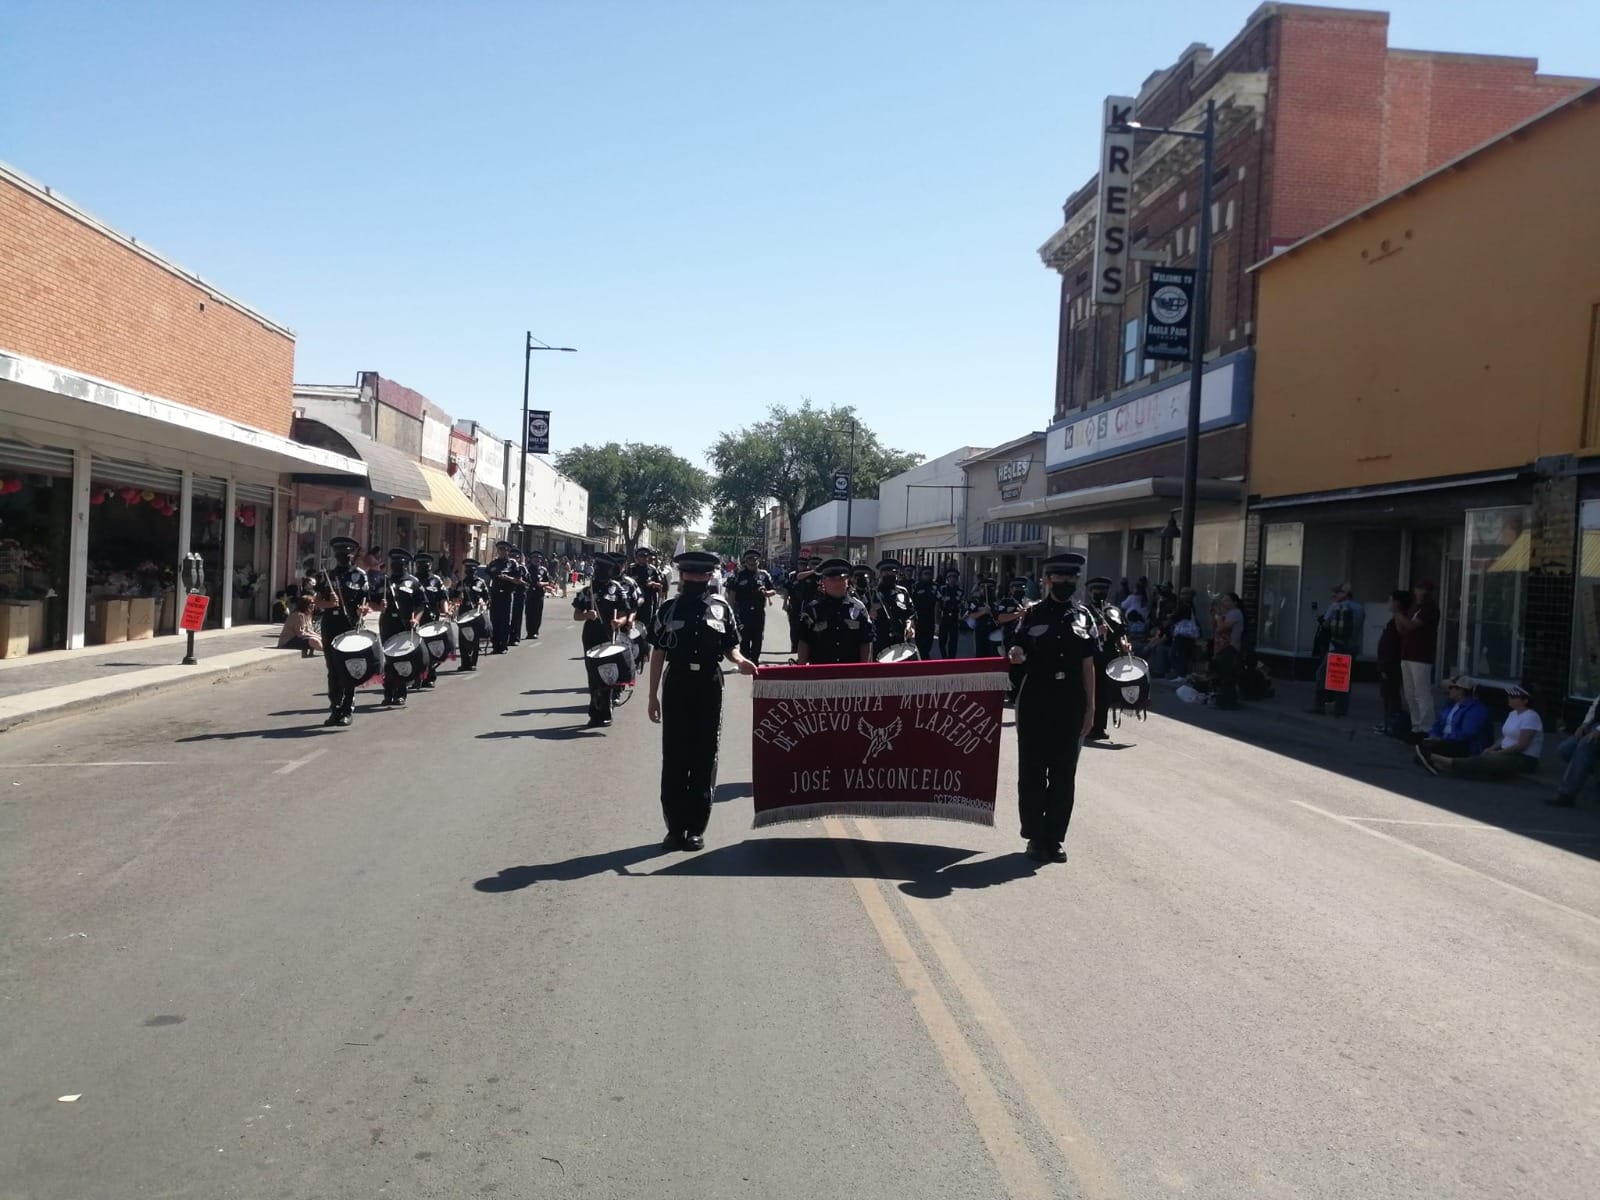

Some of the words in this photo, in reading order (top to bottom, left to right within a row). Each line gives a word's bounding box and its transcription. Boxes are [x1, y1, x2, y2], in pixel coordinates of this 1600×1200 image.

[1102, 104, 1132, 296] KRESS
[753, 694, 884, 744] PREPARATORIA
[900, 690, 999, 744] MUNICIPAL
[772, 730, 798, 753] DE
[793, 712, 850, 739] NUEVO
[914, 708, 981, 755] LAREDO
[790, 766, 831, 794] JOSÉ
[843, 767, 962, 792] VASCONCELOS
